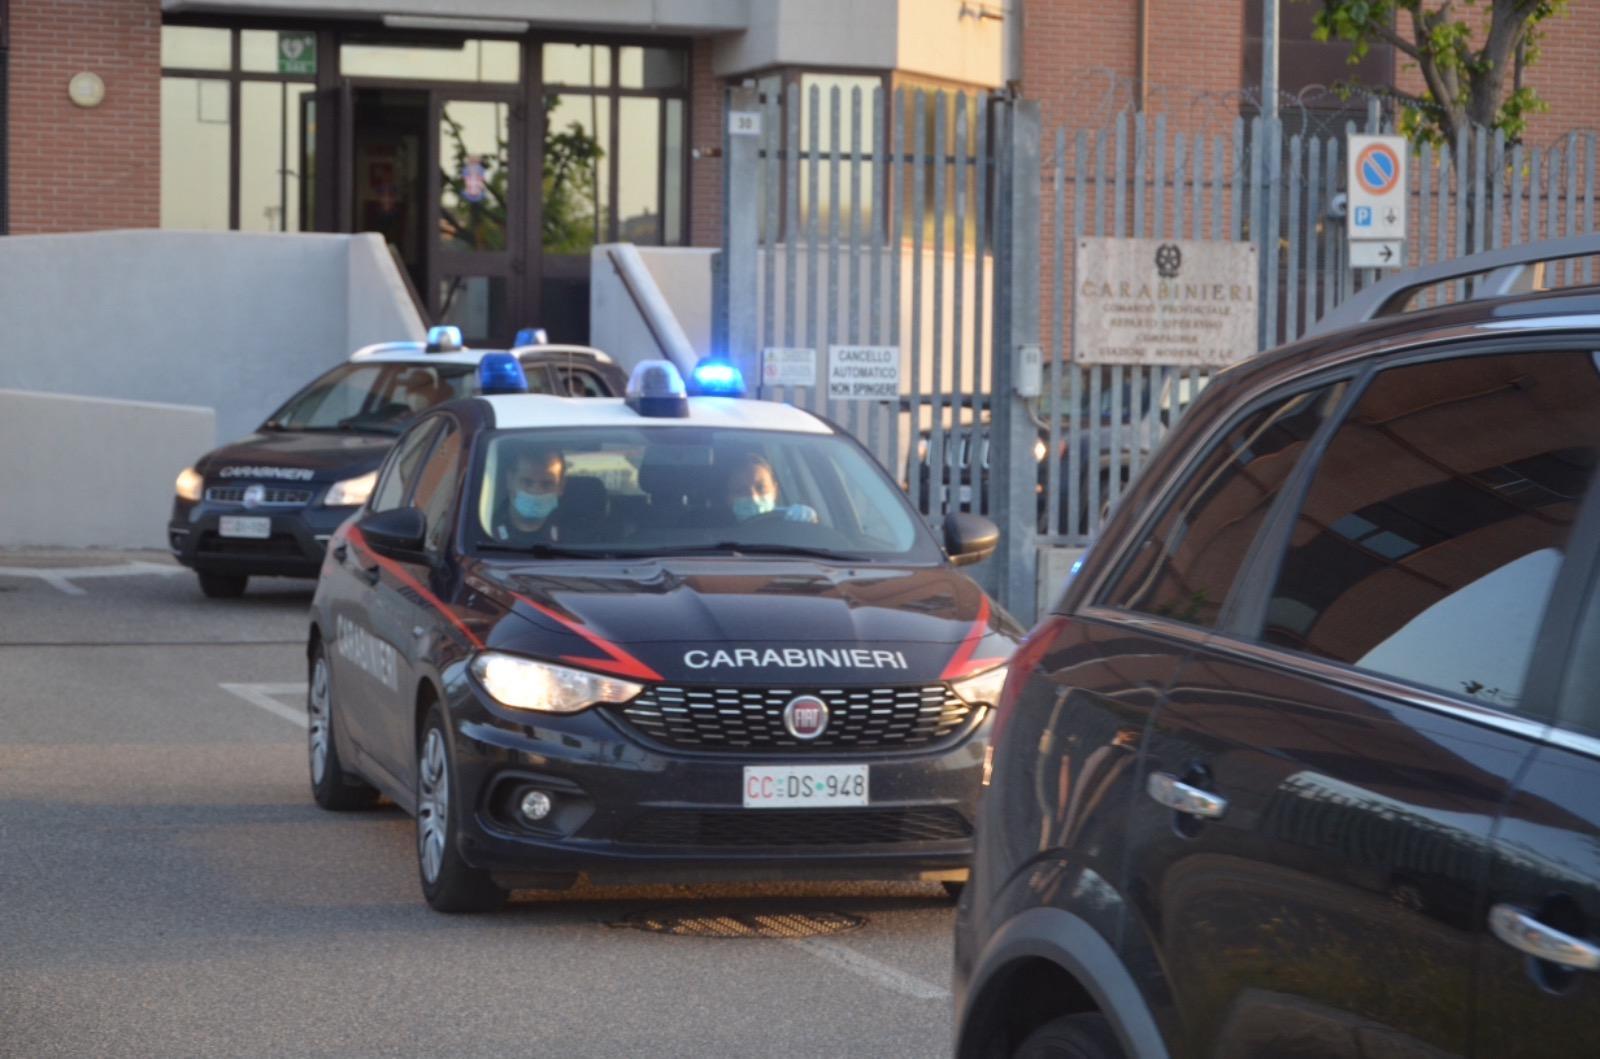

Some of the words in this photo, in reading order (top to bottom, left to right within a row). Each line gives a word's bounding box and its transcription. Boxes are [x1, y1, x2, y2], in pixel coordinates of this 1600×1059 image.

[1357, 207, 1369, 225] P
[1081, 280, 1253, 301] CARABINIERI
[838, 350, 892, 362] CANCELLO
[832, 366, 897, 378] AUTOMATICO
[831, 383, 850, 394] NON
[853, 383, 897, 396] SPINGERE
[219, 466, 315, 481] CARABINIERI
[684, 648, 909, 670] CARABINIERI
[794, 708, 819, 728] FIAT
[747, 776, 773, 798] CC
[787, 776, 813, 798] DS
[826, 774, 865, 797] 948
